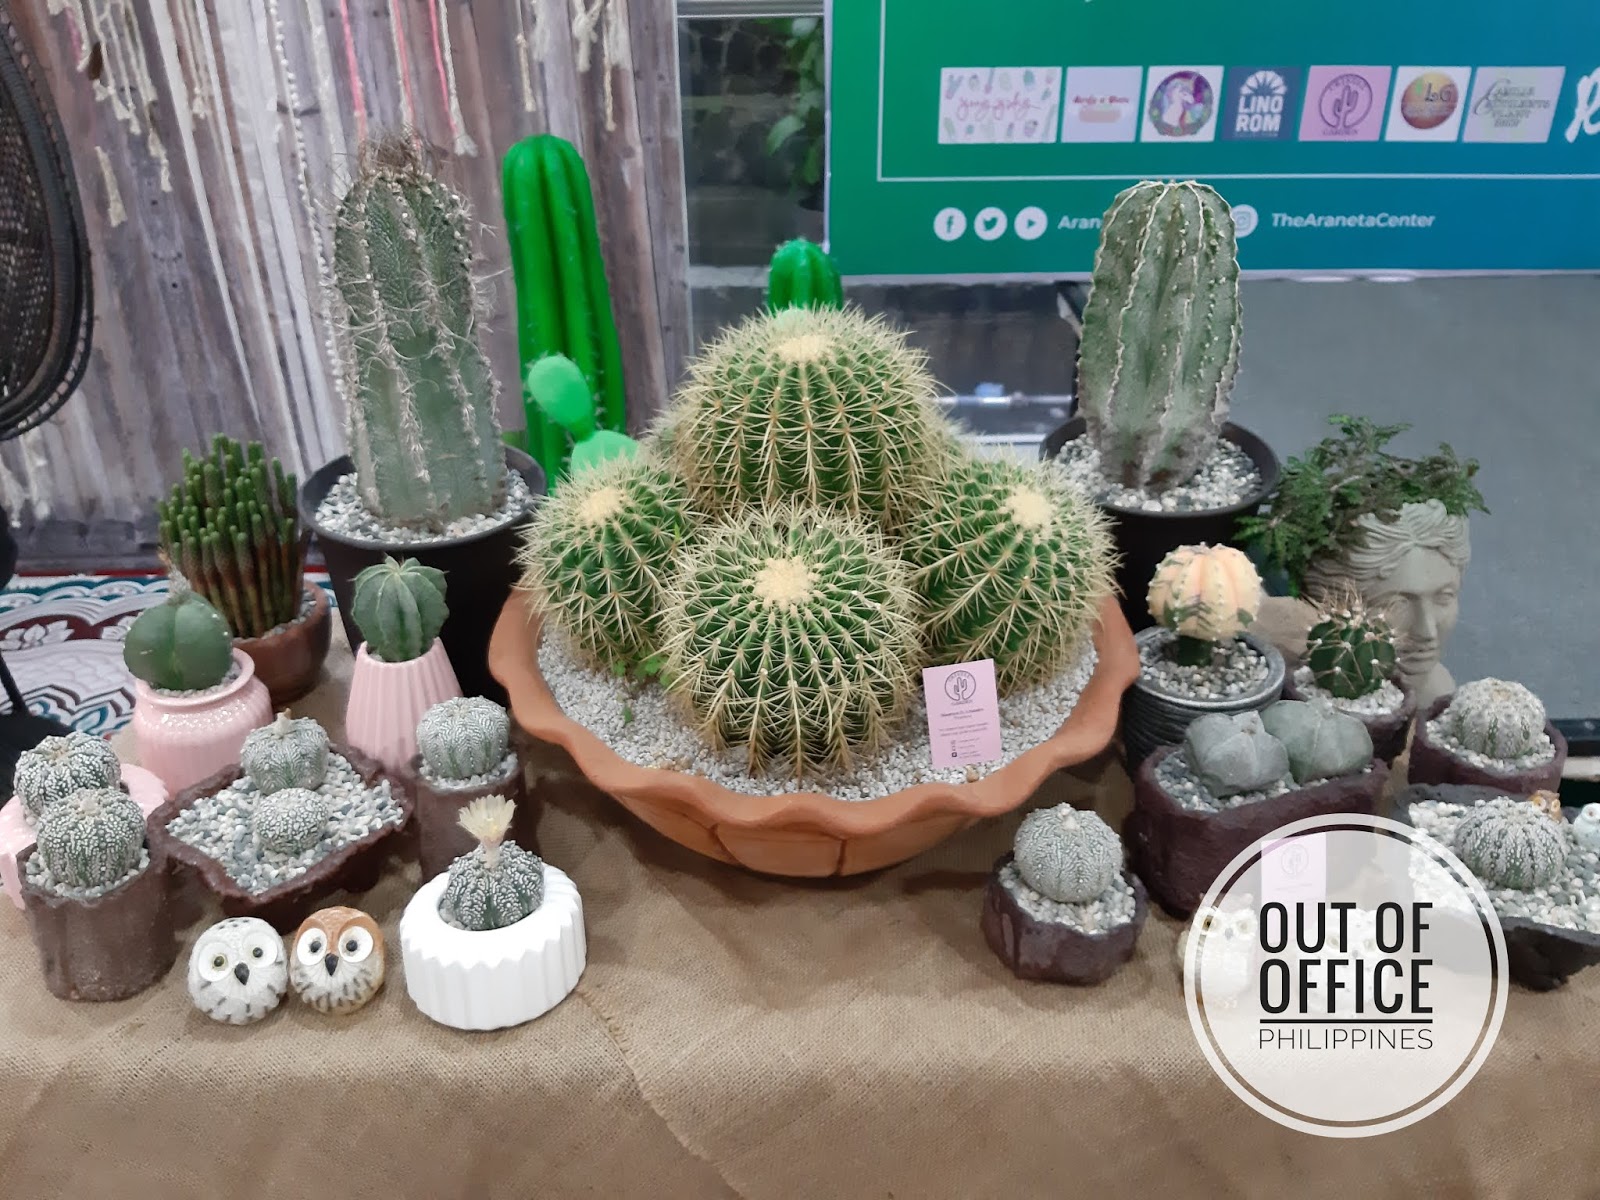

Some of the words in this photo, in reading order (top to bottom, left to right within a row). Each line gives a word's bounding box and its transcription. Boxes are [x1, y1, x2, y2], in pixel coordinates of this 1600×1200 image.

[1238, 95, 1284, 113] LINO
[1235, 114, 1281, 132] ROM
[1057, 215, 1102, 230] Aran
[1272, 212, 1435, 228] TheAranetaCenter
